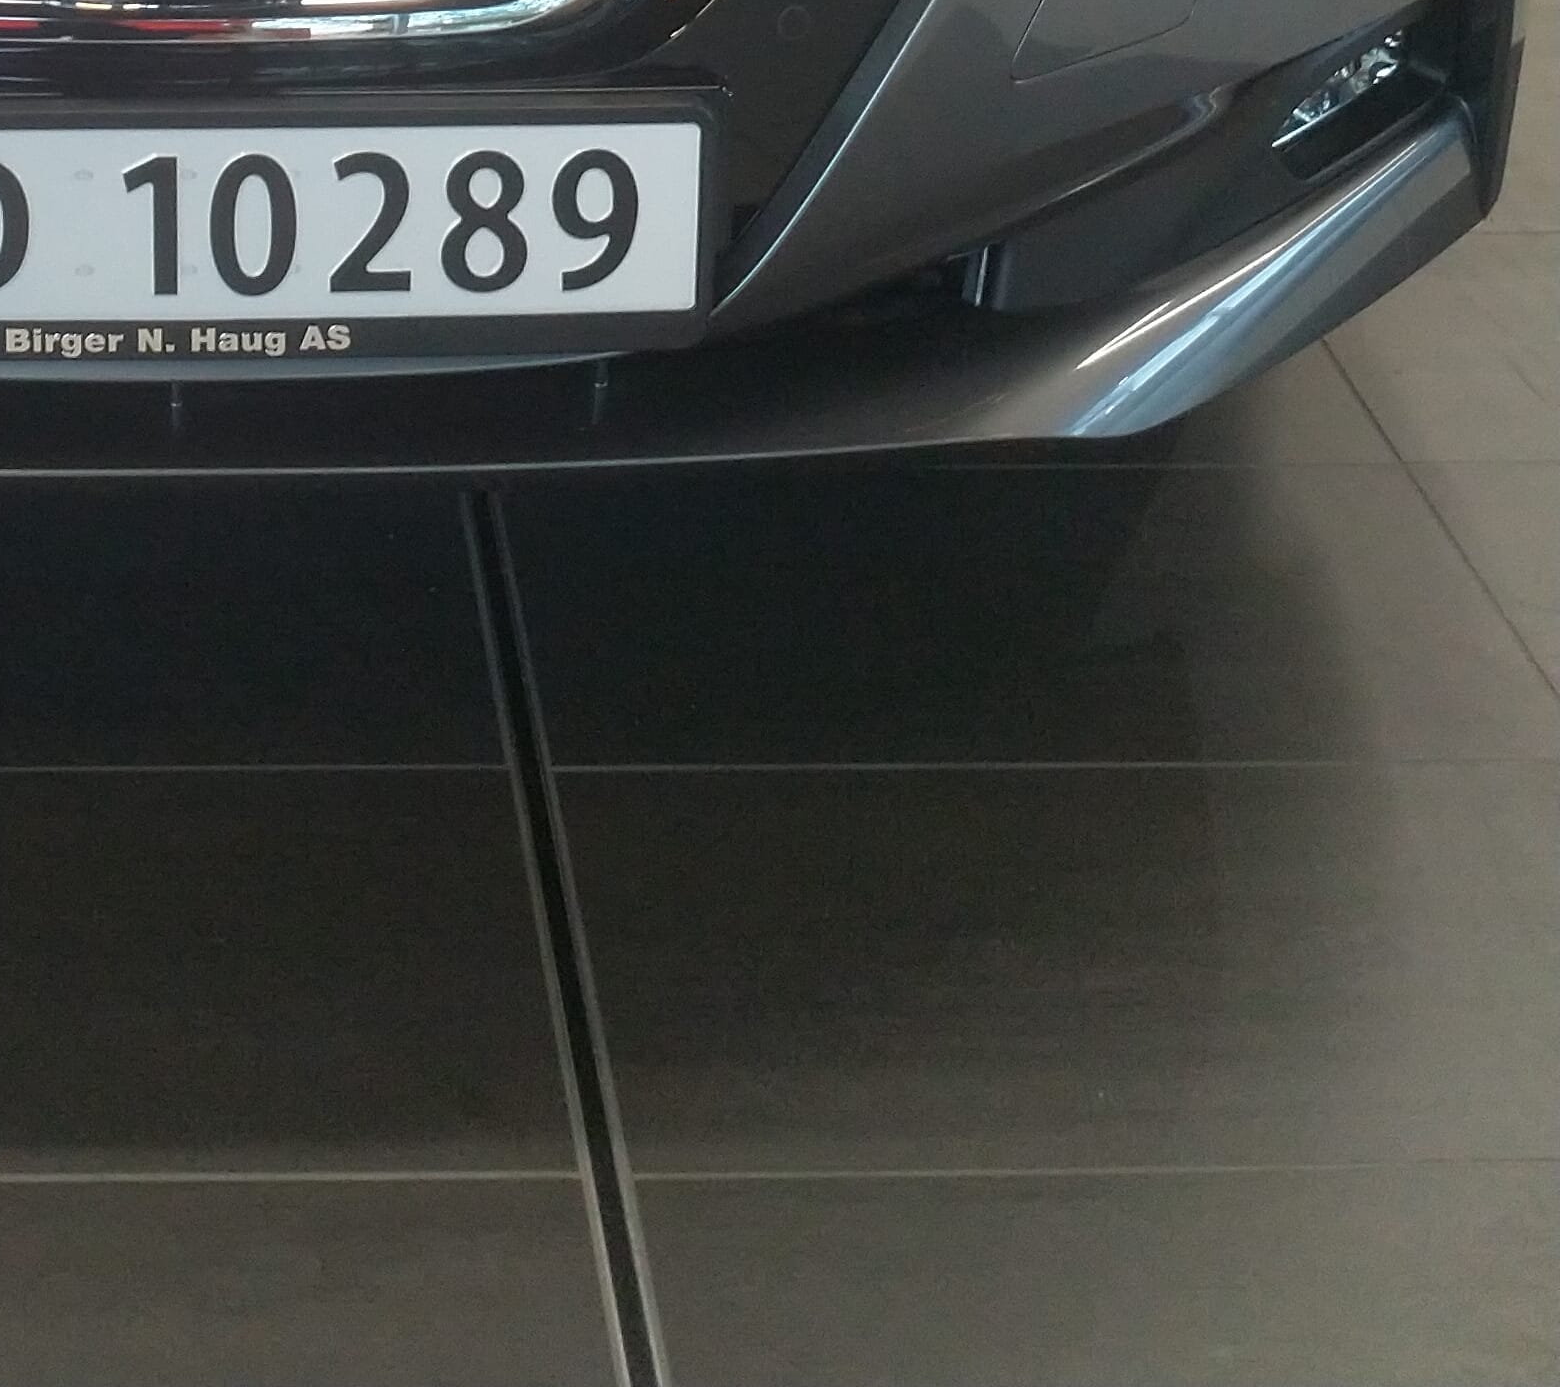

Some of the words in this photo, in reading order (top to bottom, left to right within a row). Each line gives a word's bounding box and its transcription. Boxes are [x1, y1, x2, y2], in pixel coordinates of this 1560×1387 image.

[121, 148, 639, 297] 10289
[5, 326, 124, 358] Birger
[137, 327, 177, 354] N.
[190, 326, 288, 357] Haug
[299, 323, 353, 352] AS
